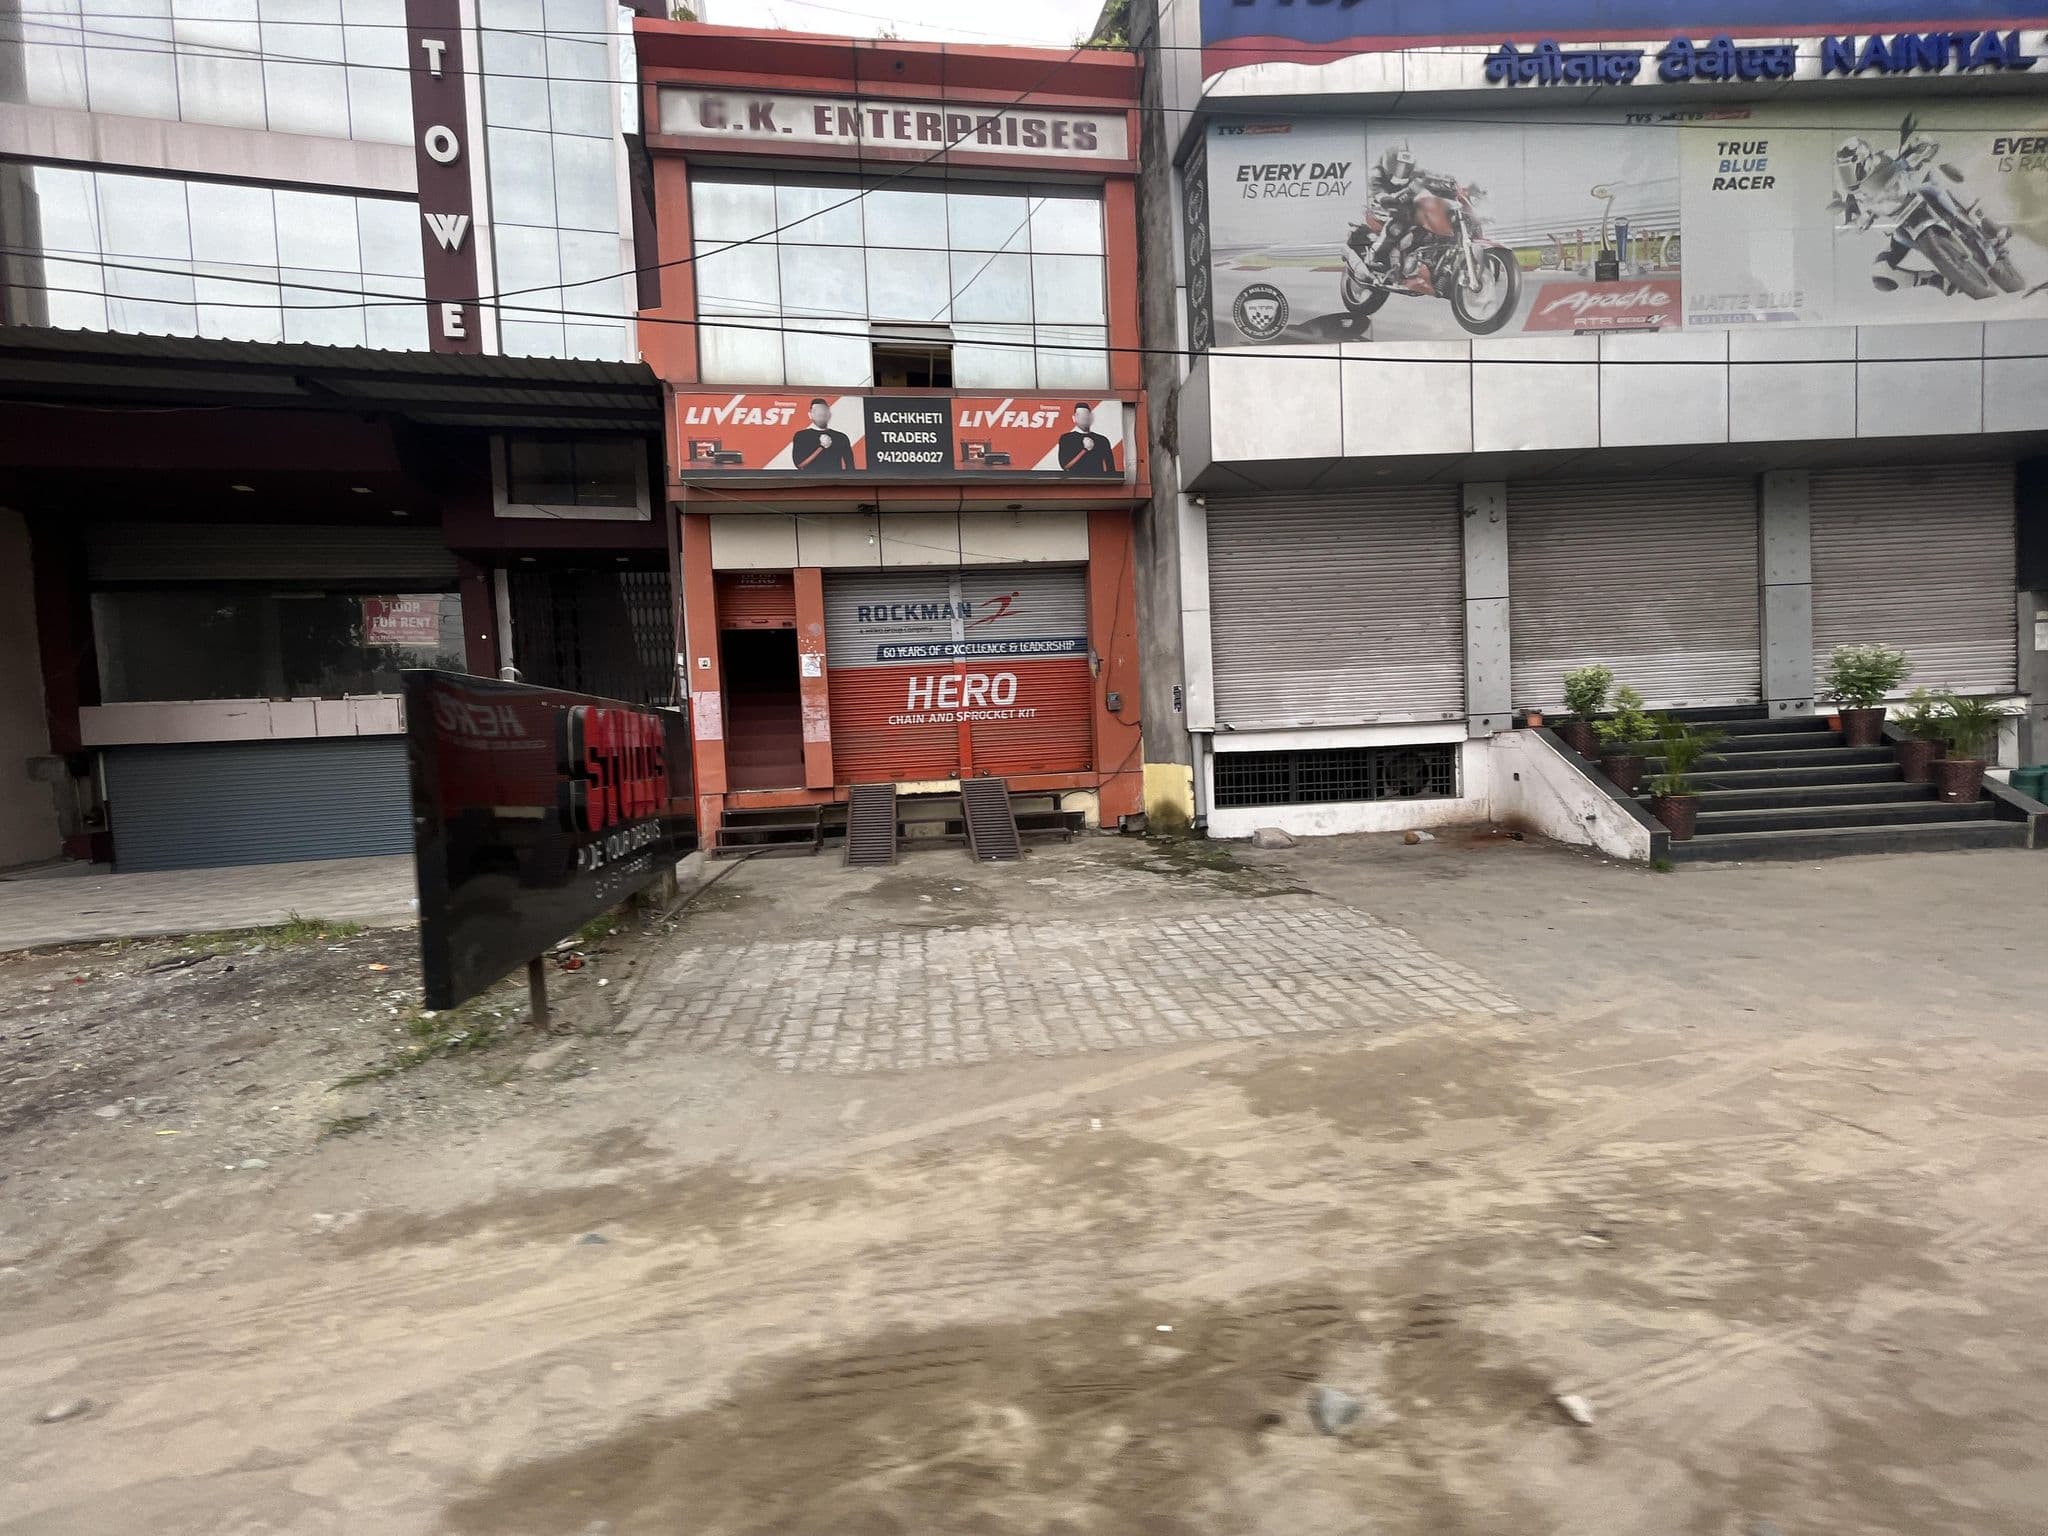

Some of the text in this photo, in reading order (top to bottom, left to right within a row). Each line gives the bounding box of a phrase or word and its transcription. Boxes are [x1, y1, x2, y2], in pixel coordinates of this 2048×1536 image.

[1656, 34, 1799, 80] टीवीएस
[1820, 29, 2037, 75] NAINITAL
[813, 104, 1098, 150] ENTERPRISES
[1717, 141, 1768, 155] TRUE
[1236, 162, 1352, 182] EVERY DAY
[1719, 158, 1768, 173] BLUE
[1243, 181, 1352, 199] IS RACE DAY
[1712, 176, 1776, 190] RACER
[1539, 285, 1672, 316] Apache
[685, 395, 796, 425] LIVFAST
[873, 411, 943, 424] BACHKHETI
[959, 399, 1060, 428] LIVFAST
[881, 431, 937, 444] TRADERS
[877, 451, 943, 463] 9412086027
[381, 601, 420, 613] FLOOR
[857, 603, 973, 622] ROCKMAN
[372, 616, 431, 628] FOR RENT
[883, 640, 1076, 659] 60 YEARS OF EXCELLENCE & LEADERSHIP
[907, 672, 1018, 710] HERO
[888, 708, 1038, 726] CHAIN AND SPROCKET KIT
